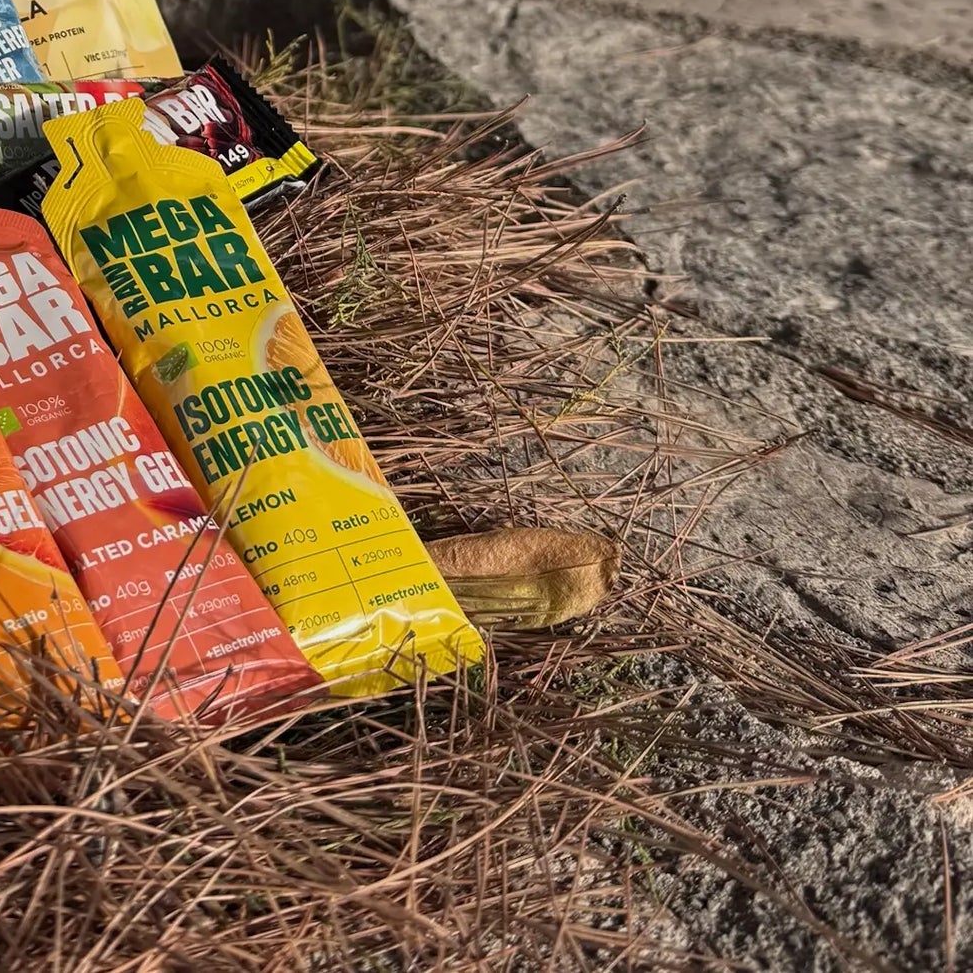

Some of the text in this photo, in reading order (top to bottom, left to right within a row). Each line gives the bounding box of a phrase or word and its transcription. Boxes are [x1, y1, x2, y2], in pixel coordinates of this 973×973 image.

[49, 27, 86, 42] PROTEIN
[84, 53, 102, 63] VitC
[156, 84, 228, 135] BAR
[218, 143, 250, 168] 149
[78, 194, 237, 267] MEGA
[101, 231, 267, 320] RAW BAR
[133, 288, 280, 344] MALLORCA
[195, 337, 241, 355] 100%
[203, 350, 247, 365] ORGANIC
[17, 394, 66, 418] 100%
[27, 406, 73, 427] ORGANIC
[173, 365, 313, 443] ISOTONIC
[14, 416, 142, 492] SOTONIC
[192, 401, 361, 486] ENERGY GEL
[34, 451, 191, 534] NERGY GEL
[243, 505, 401, 566] Cho 40g Ratio 1:0.8
[282, 570, 318, 589] 48mg
[351, 556, 362, 568] K
[362, 545, 404, 564] 290mg
[115, 578, 152, 603] 40g
[188, 607, 199, 620] K
[199, 591, 242, 615] 290mg
[298, 580, 441, 632] 200mg +Electrolytes
[1, 608, 50, 635] Ratio
[205, 625, 283, 660] +Electrolytes
